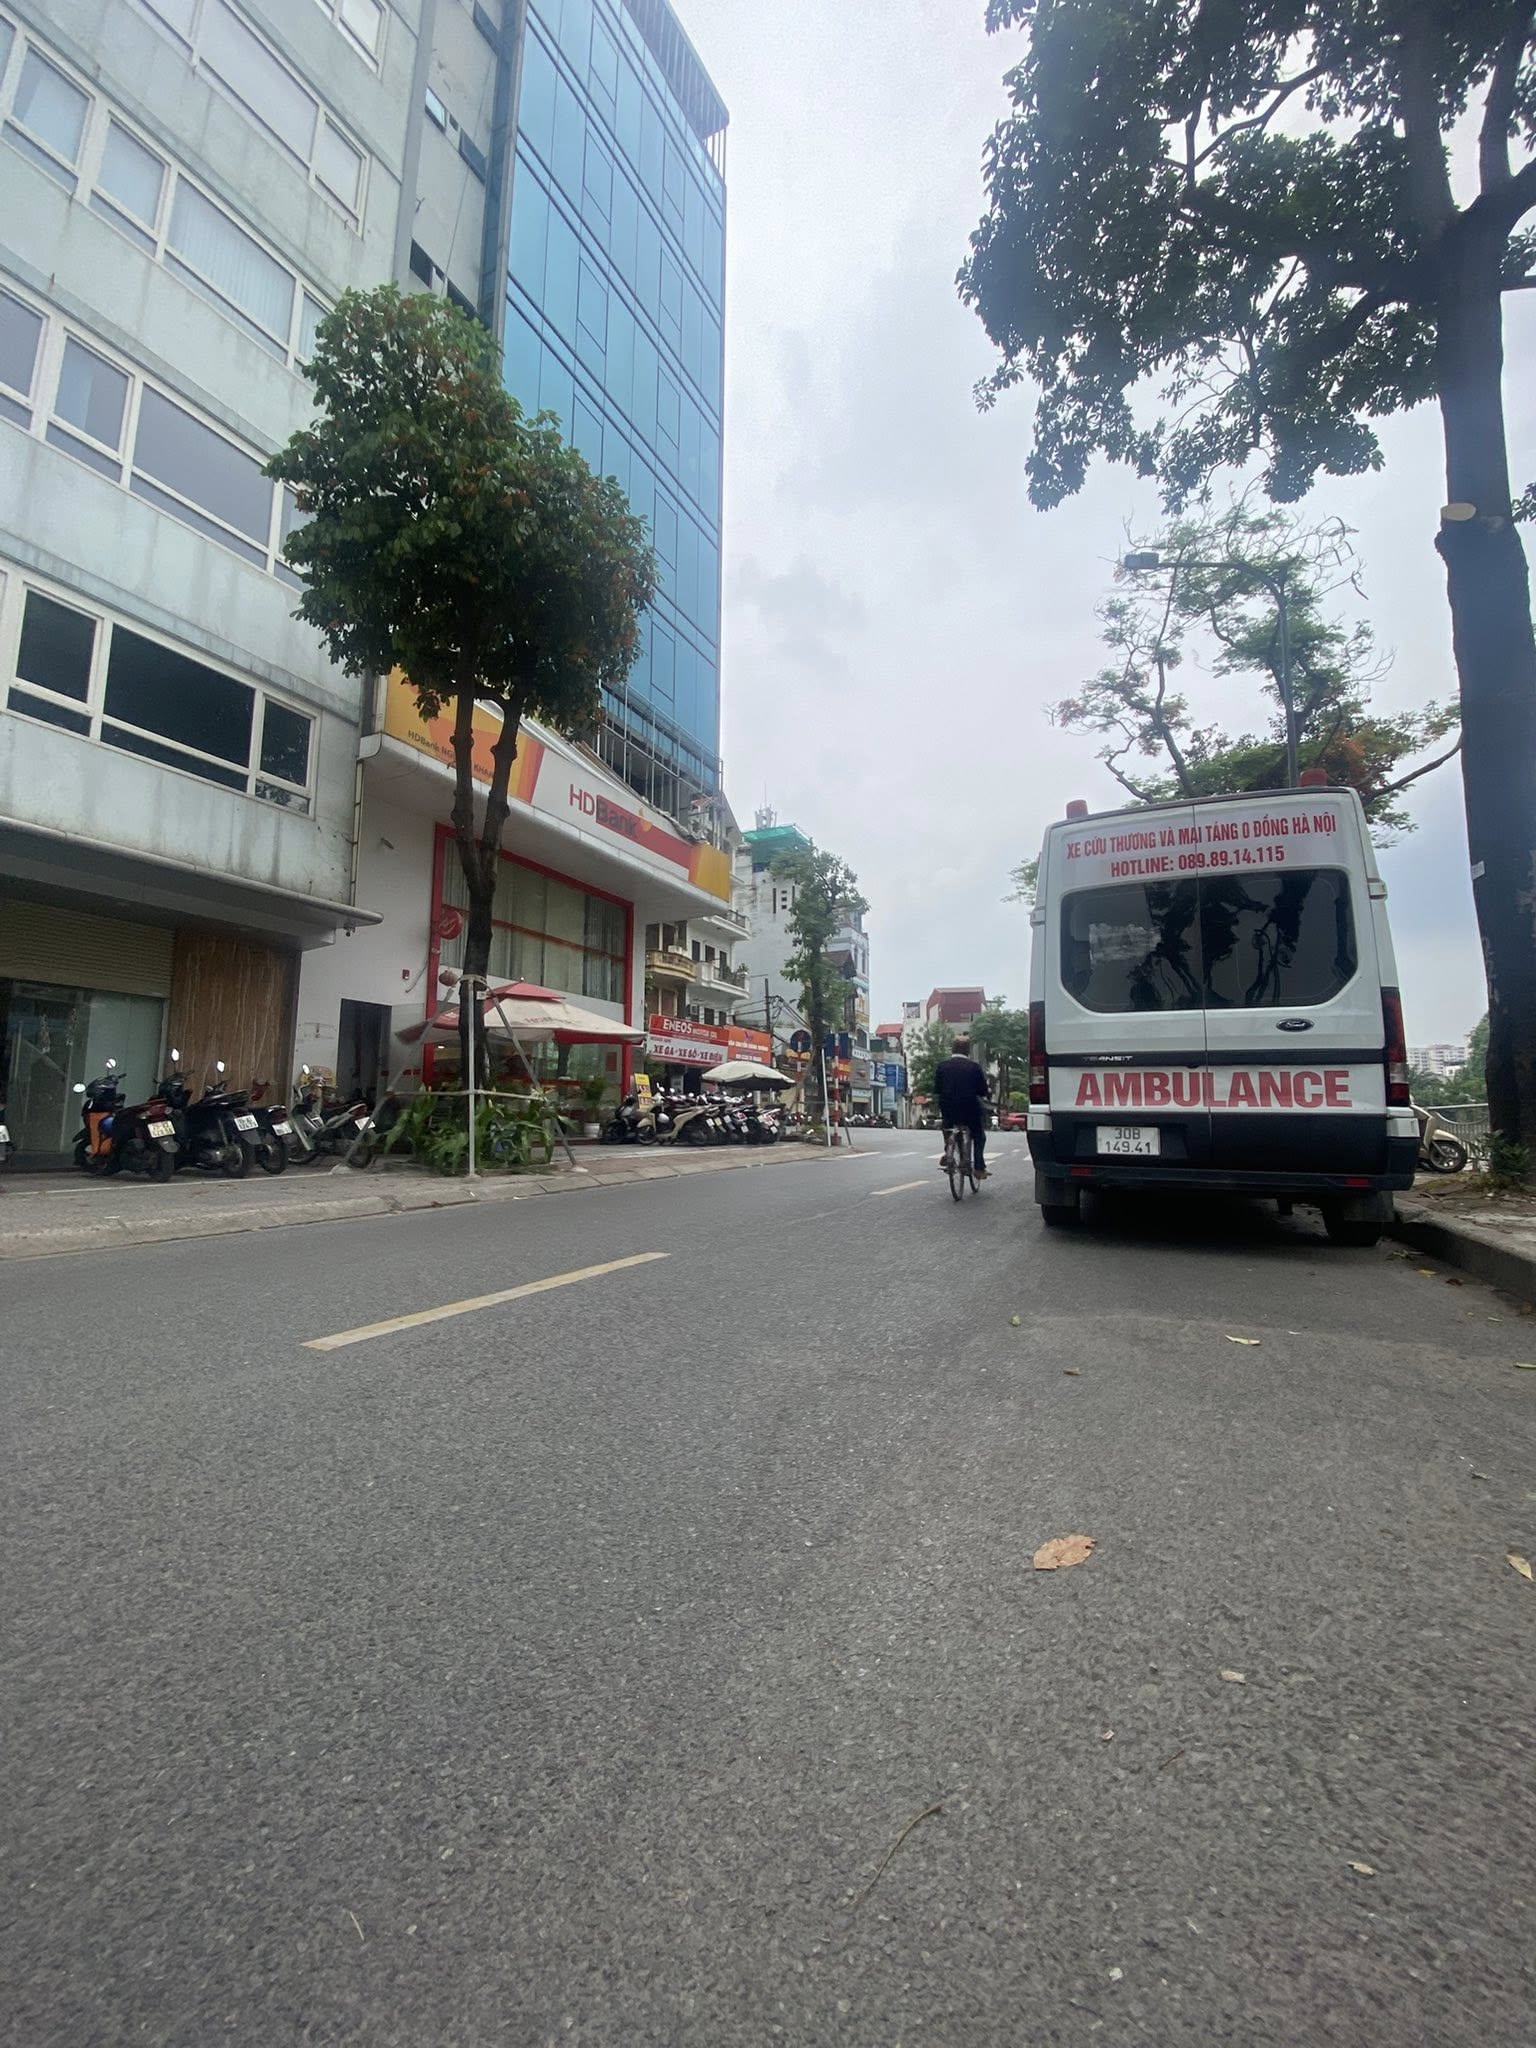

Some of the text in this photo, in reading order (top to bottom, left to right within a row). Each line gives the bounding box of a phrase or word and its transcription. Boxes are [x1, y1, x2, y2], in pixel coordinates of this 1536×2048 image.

[569, 783, 637, 836] HDBank
[1066, 841, 1081, 859] XE
[1084, 835, 1106, 857] CỨU
[1110, 830, 1156, 853] THƯƠNG
[1159, 825, 1175, 847] VÀ
[1179, 825, 1202, 846] MAI
[1205, 821, 1239, 842] TÁNG
[1292, 812, 1310, 834] HÀ
[1313, 811, 1337, 837] NỘI
[1111, 845, 1285, 877] HOTLINE: 089.89.14.115
[662, 1018, 693, 1034] ENEOS
[654, 1044, 664, 1054] XE
[678, 1047, 688, 1057] XE
[1074, 1070, 1353, 1109] AMBULANCE
[1114, 1127, 1141, 1140] 30B
[1105, 1140, 1151, 1153] 149.41
